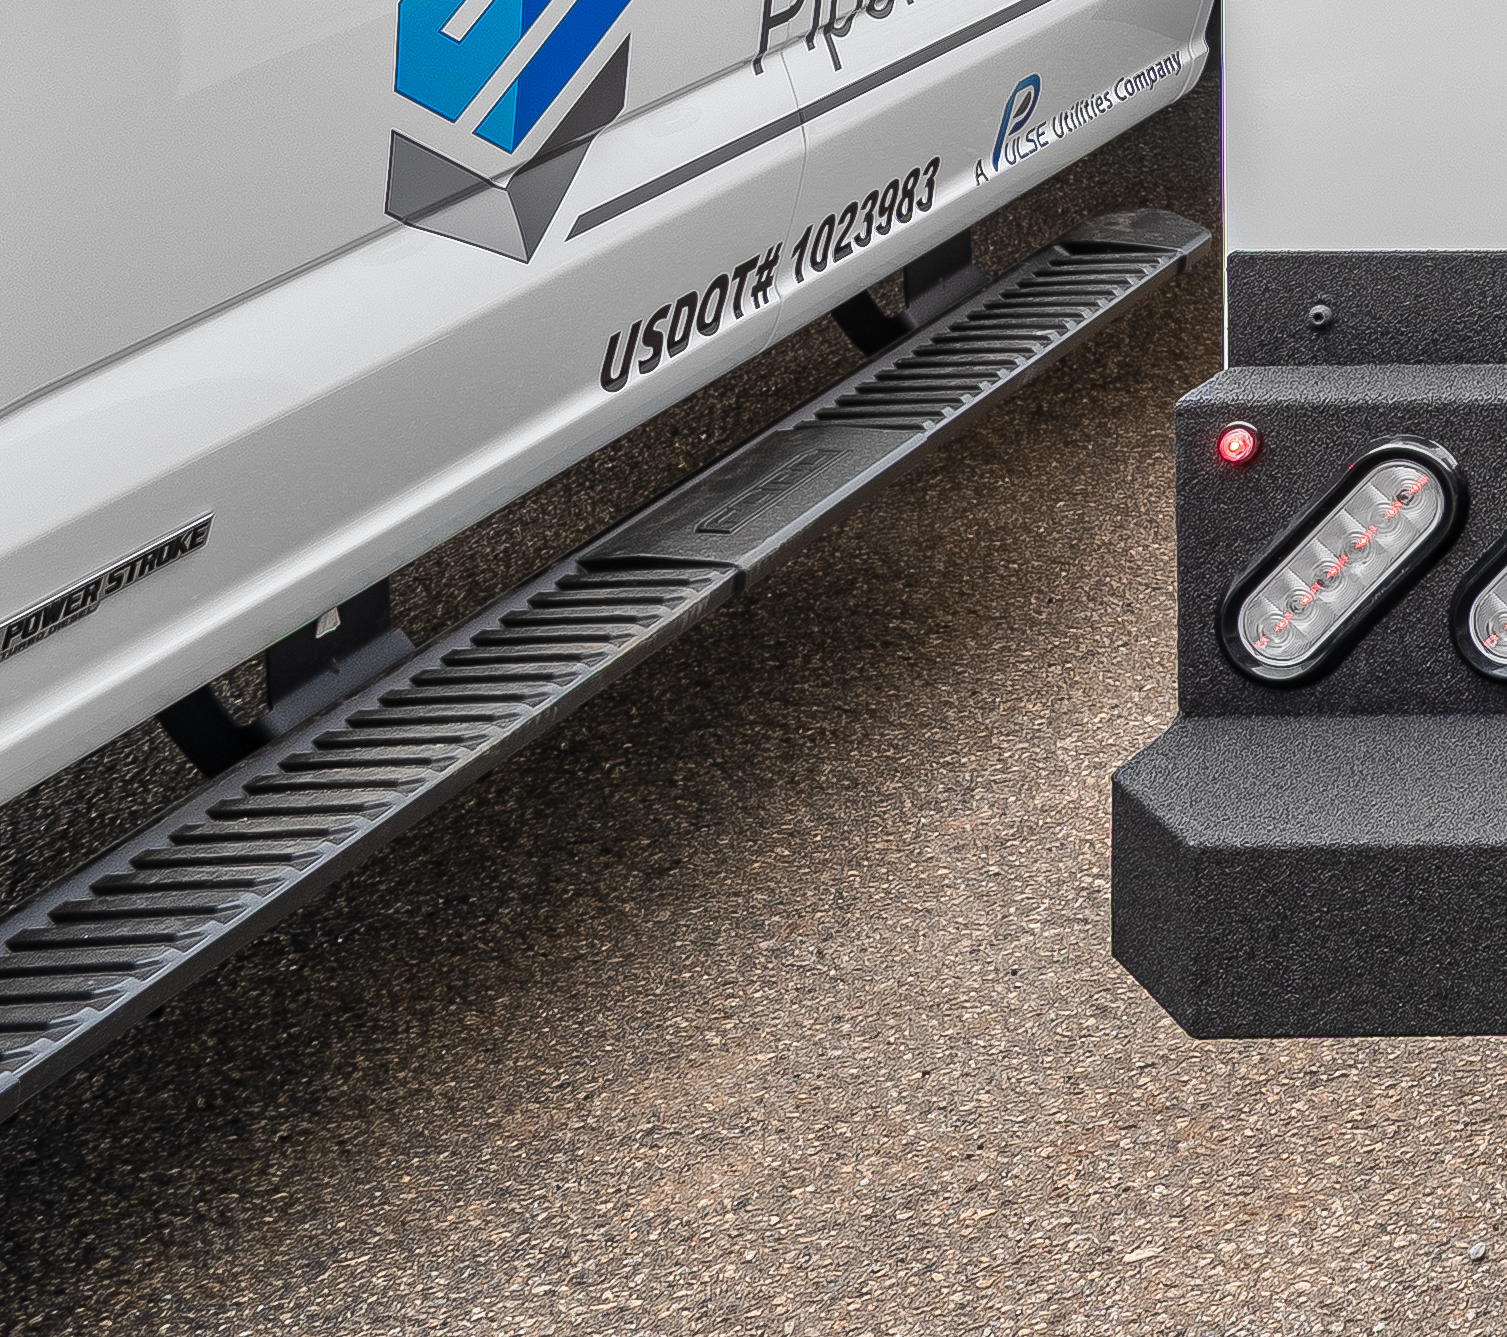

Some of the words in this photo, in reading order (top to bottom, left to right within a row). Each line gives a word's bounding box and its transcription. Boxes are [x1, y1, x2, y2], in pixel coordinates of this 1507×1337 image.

[975, 158, 990, 187] A
[992, 73, 1050, 172] PULSE
[1051, 90, 1113, 140] Utilities
[1113, 50, 1183, 102] Company
[599, 241, 784, 394] USDOT#
[790, 155, 941, 284] 1023983
[1, 575, 101, 652] POWER
[104, 520, 210, 596] STROKE
